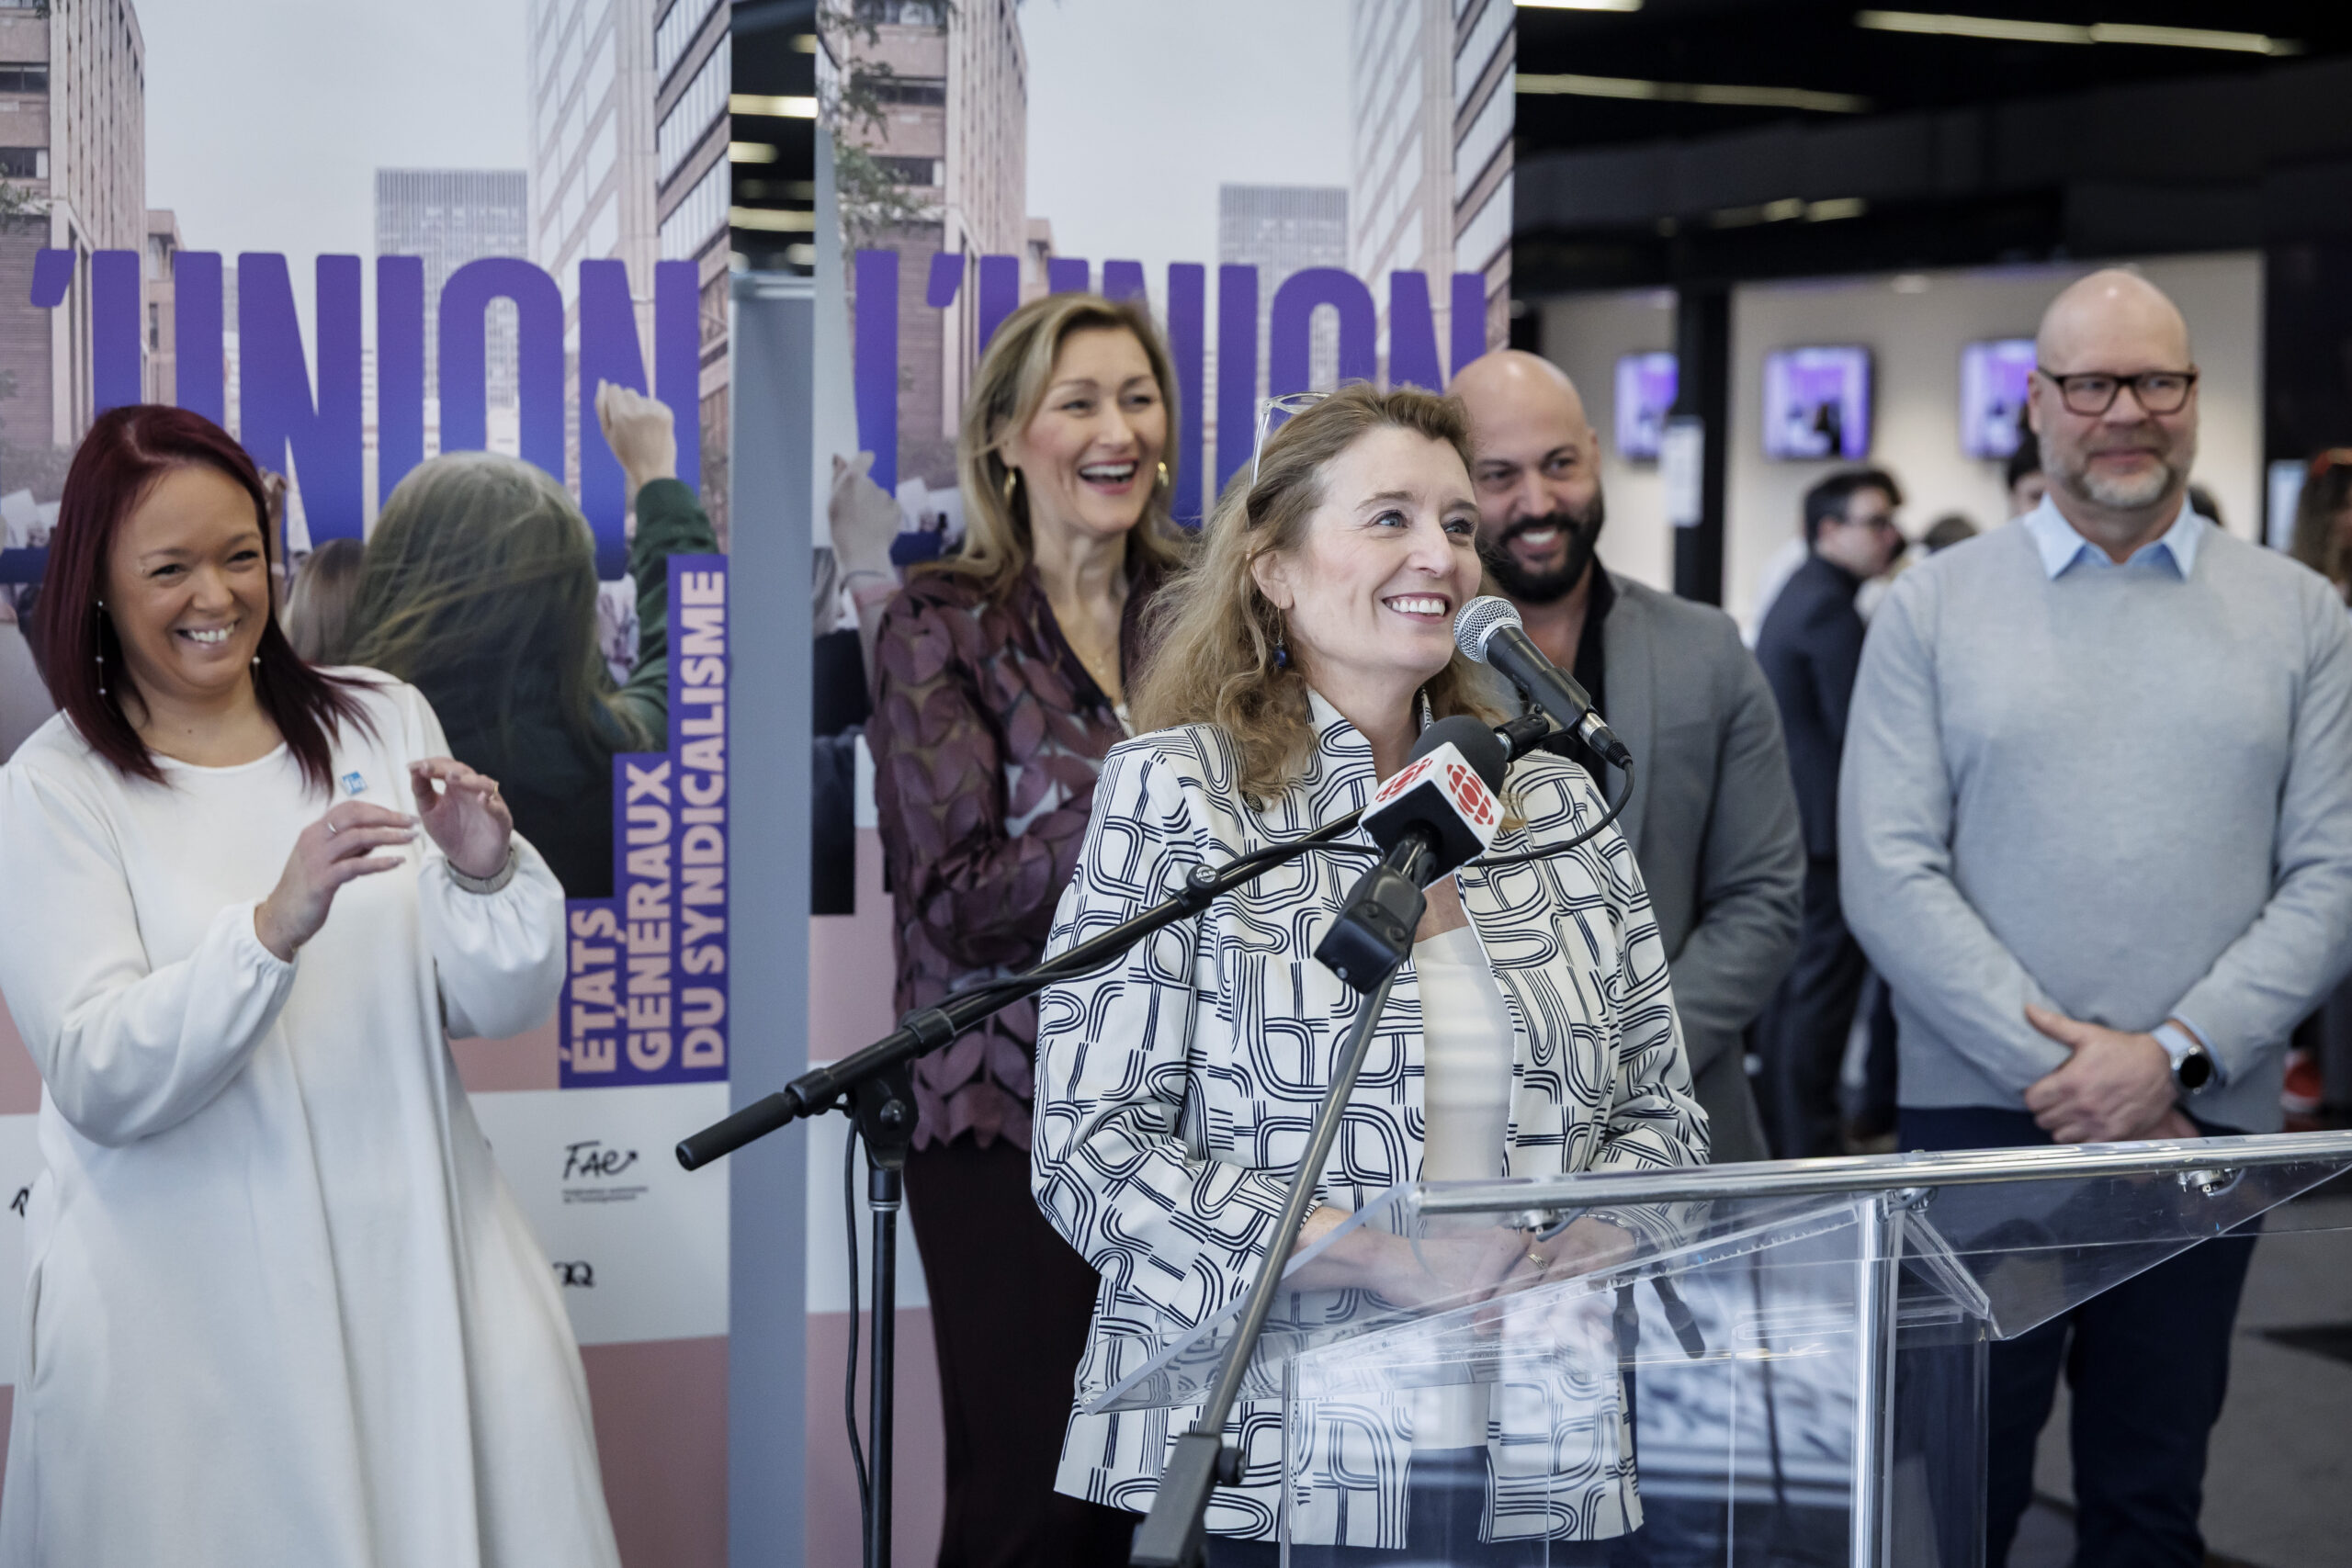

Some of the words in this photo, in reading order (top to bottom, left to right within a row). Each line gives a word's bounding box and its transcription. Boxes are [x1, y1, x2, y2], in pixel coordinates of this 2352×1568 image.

[0, 248, 700, 582] 'NION
[616, 761, 672, 1071] GÉNÉRAUX
[681, 571, 725, 974] SYNDICALISME
[560, 907, 616, 1073] ÉTATS
[681, 987, 725, 1068] DU
